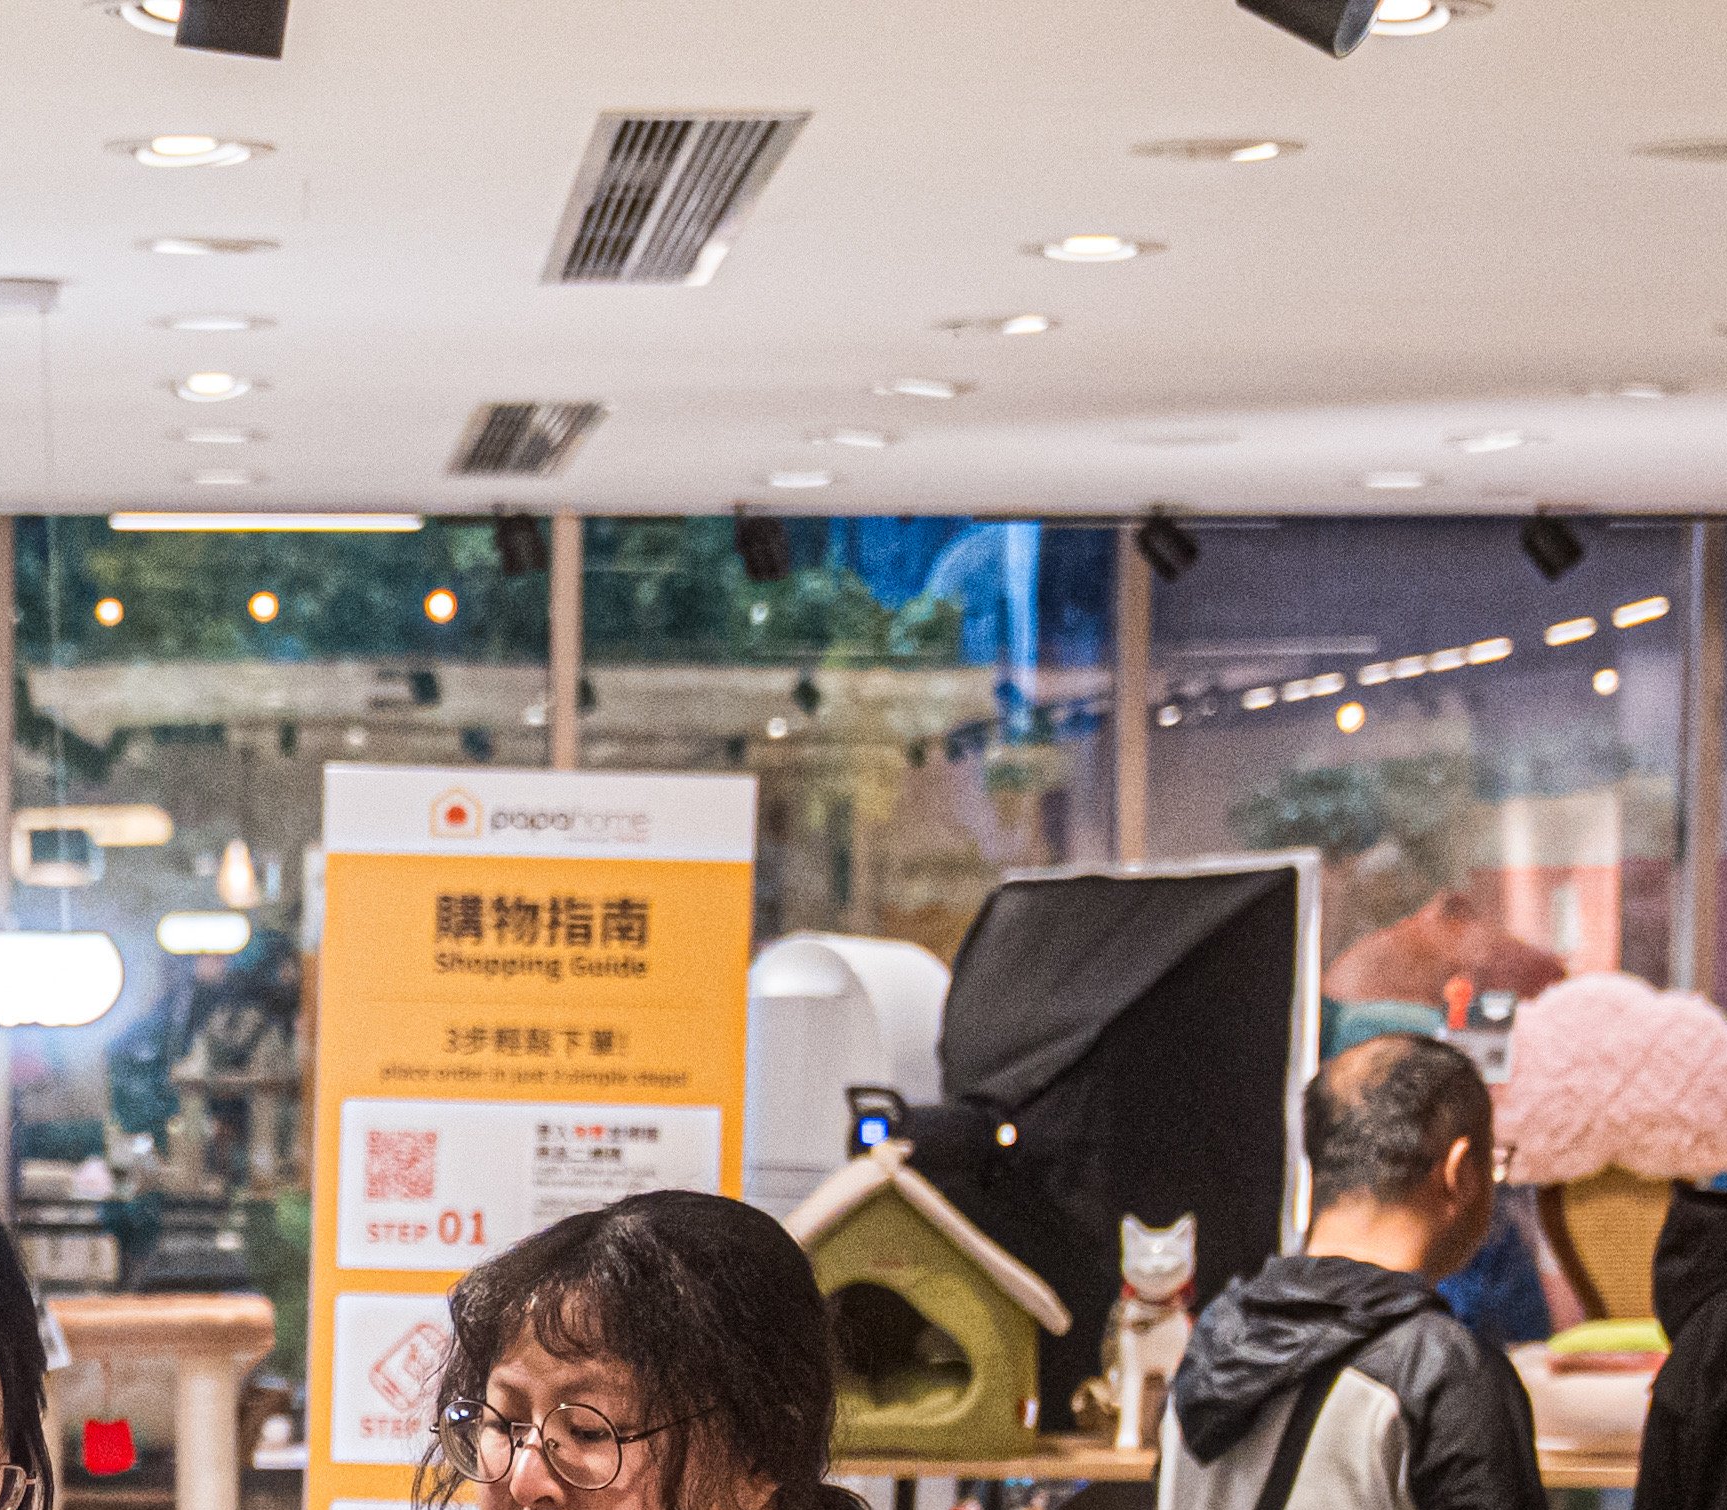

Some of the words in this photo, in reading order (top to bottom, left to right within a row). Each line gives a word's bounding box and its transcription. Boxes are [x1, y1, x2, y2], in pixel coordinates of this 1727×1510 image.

[435, 895, 650, 947] 購物指南
[435, 953, 561, 981] Shopping
[571, 956, 647, 977] Guide
[367, 1222, 428, 1243] STEP
[438, 1209, 487, 1245] 01
[360, 1415, 421, 1440] STEP
